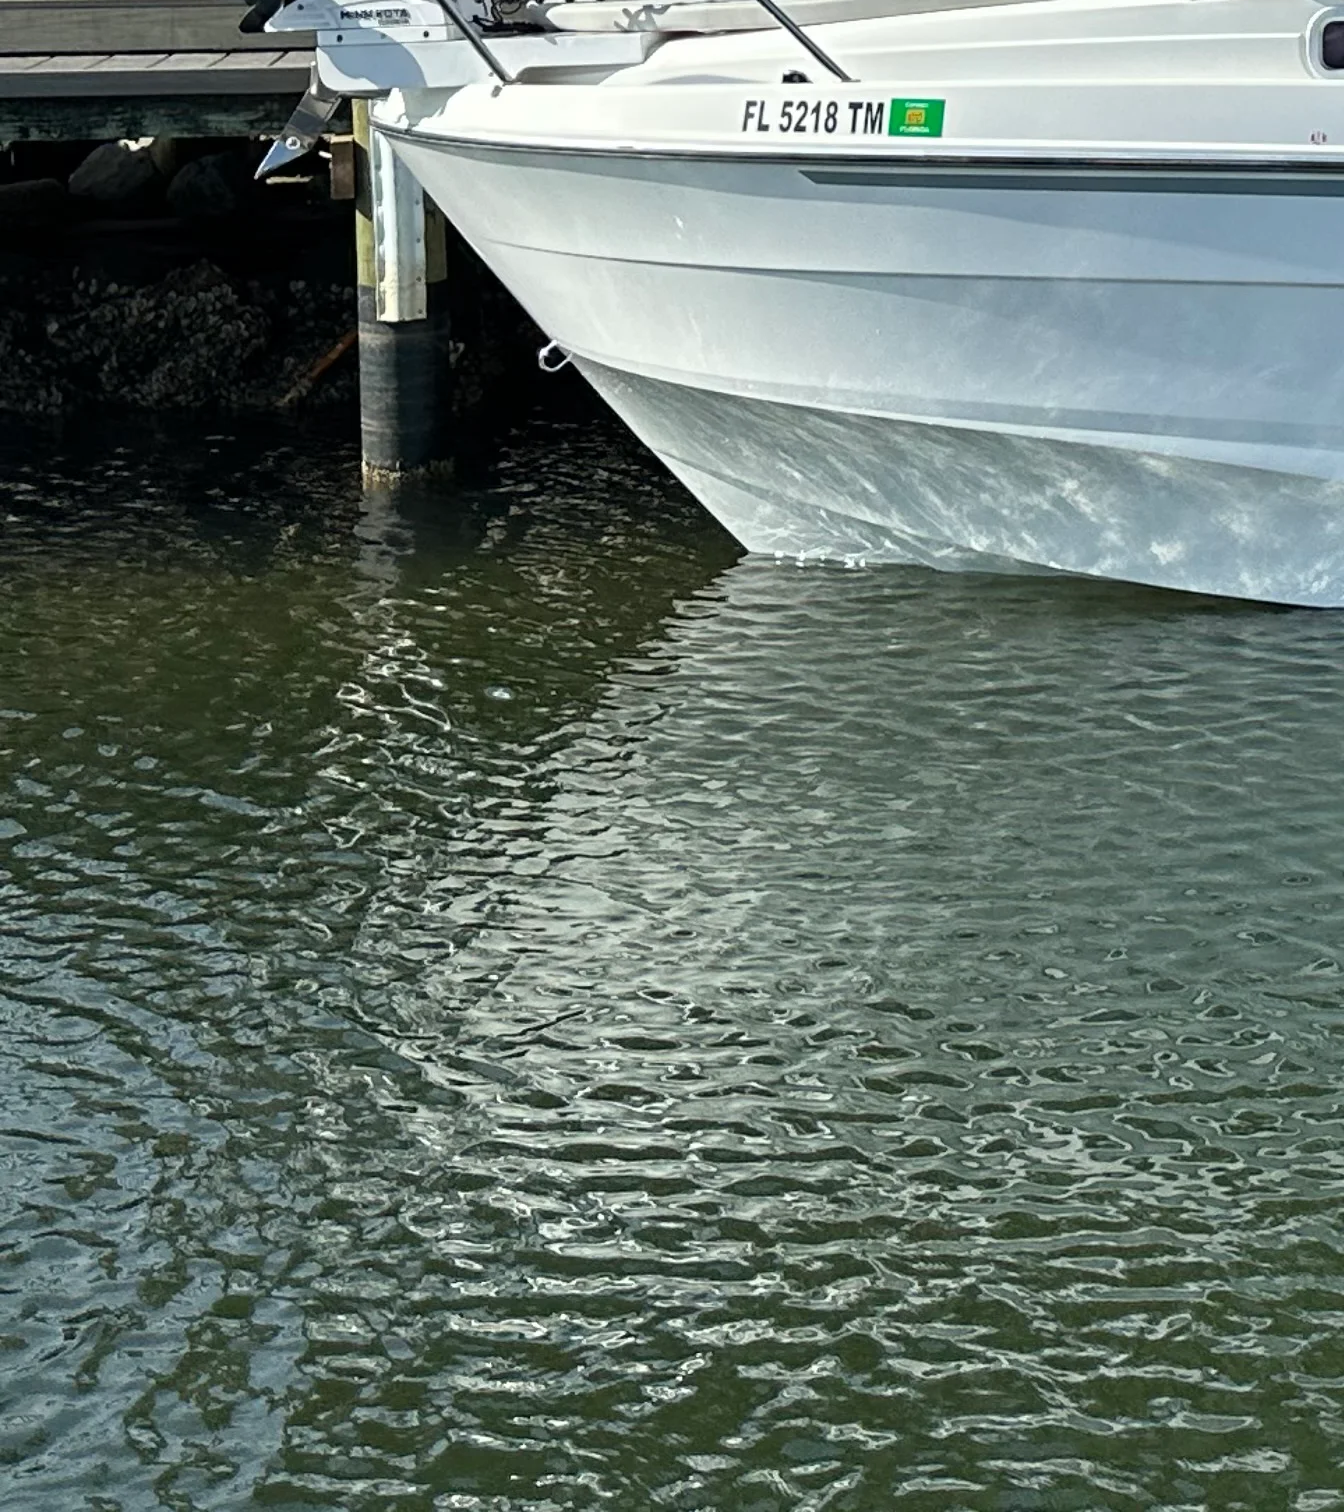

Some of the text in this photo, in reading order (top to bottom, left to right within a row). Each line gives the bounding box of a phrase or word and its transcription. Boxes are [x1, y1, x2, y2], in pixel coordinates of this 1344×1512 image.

[742, 100, 885, 135] FL 5218 TM
